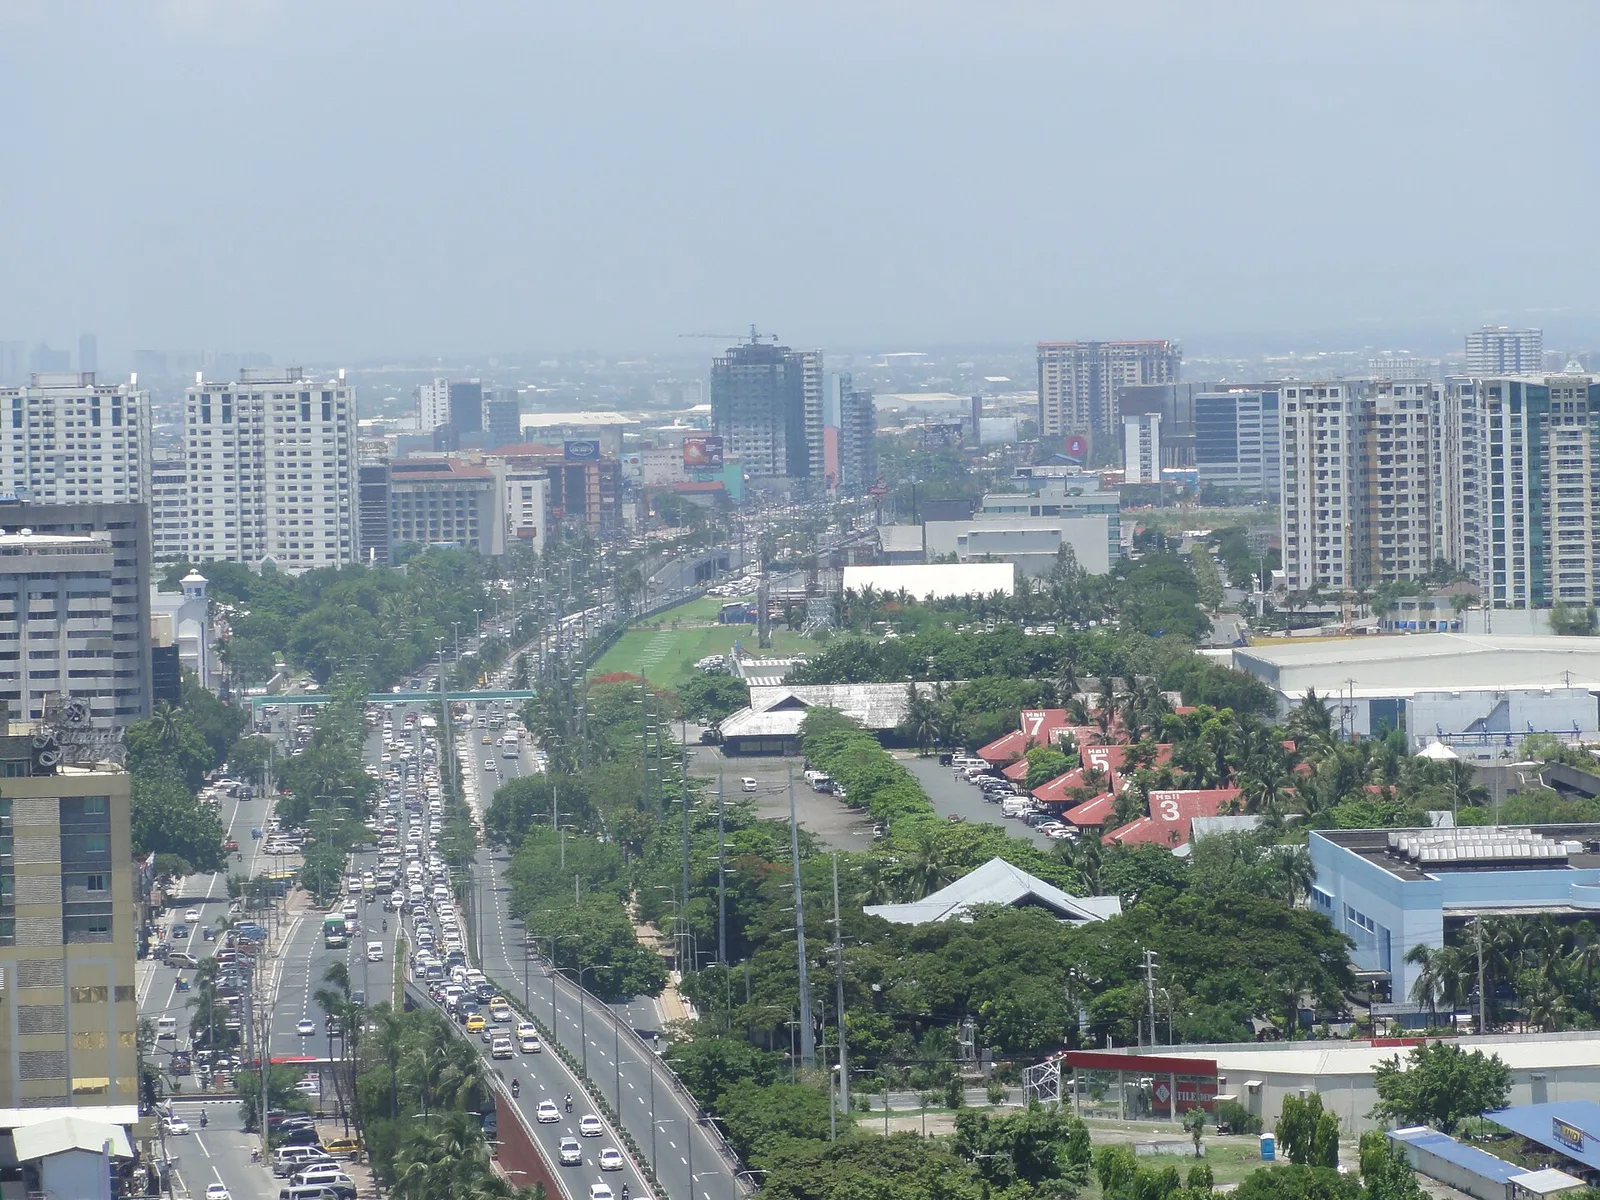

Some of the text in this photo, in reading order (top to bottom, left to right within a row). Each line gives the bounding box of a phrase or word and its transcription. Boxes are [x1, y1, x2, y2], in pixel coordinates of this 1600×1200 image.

[1028, 717, 1044, 736] 7
[1090, 754, 1110, 773] 5
[1160, 800, 1180, 821] 3
[1177, 1091, 1197, 1101] TILE
